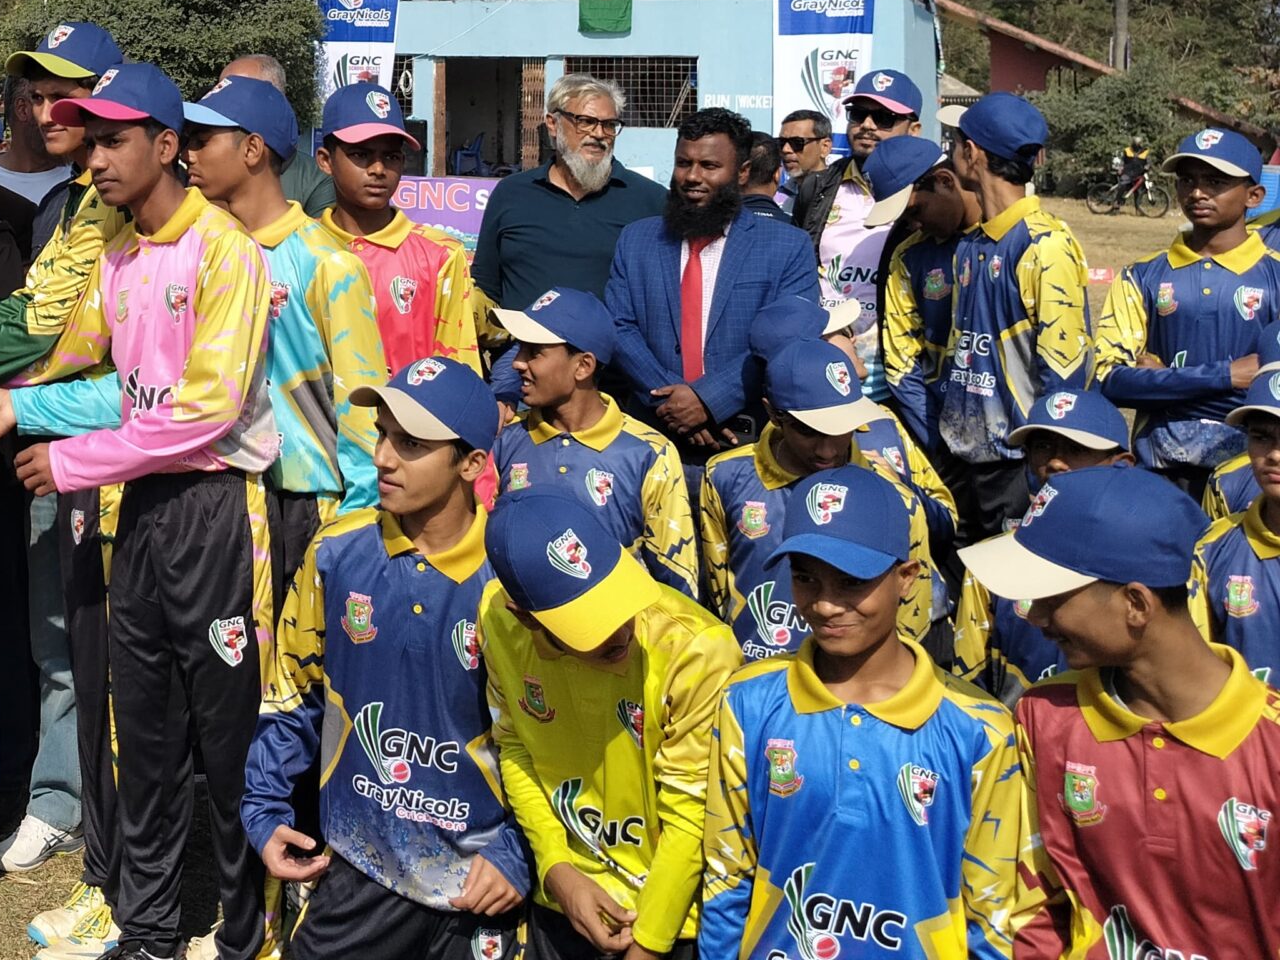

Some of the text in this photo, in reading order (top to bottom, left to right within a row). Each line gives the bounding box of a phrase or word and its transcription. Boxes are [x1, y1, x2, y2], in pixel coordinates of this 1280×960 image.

[328, 8, 390, 22] GrayNicols
[349, 56, 382, 65] GNC
[821, 49, 859, 60] GNC
[704, 94, 730, 107] RUN
[391, 180, 470, 211] GNC
[271, 281, 291, 290] GNC
[820, 483, 848, 493] GNC
[554, 530, 573, 549] GNC
[219, 617, 243, 628] GNC
[766, 601, 813, 632] GN
[626, 701, 644, 710] GN
[379, 728, 460, 773] GNC
[911, 766, 940, 782] GNC
[353, 775, 469, 819] GrayNicols
[396, 807, 467, 831] Cricketers
[1236, 803, 1271, 821] GNC
[578, 806, 645, 847] GNC
[805, 894, 907, 950] GNC
